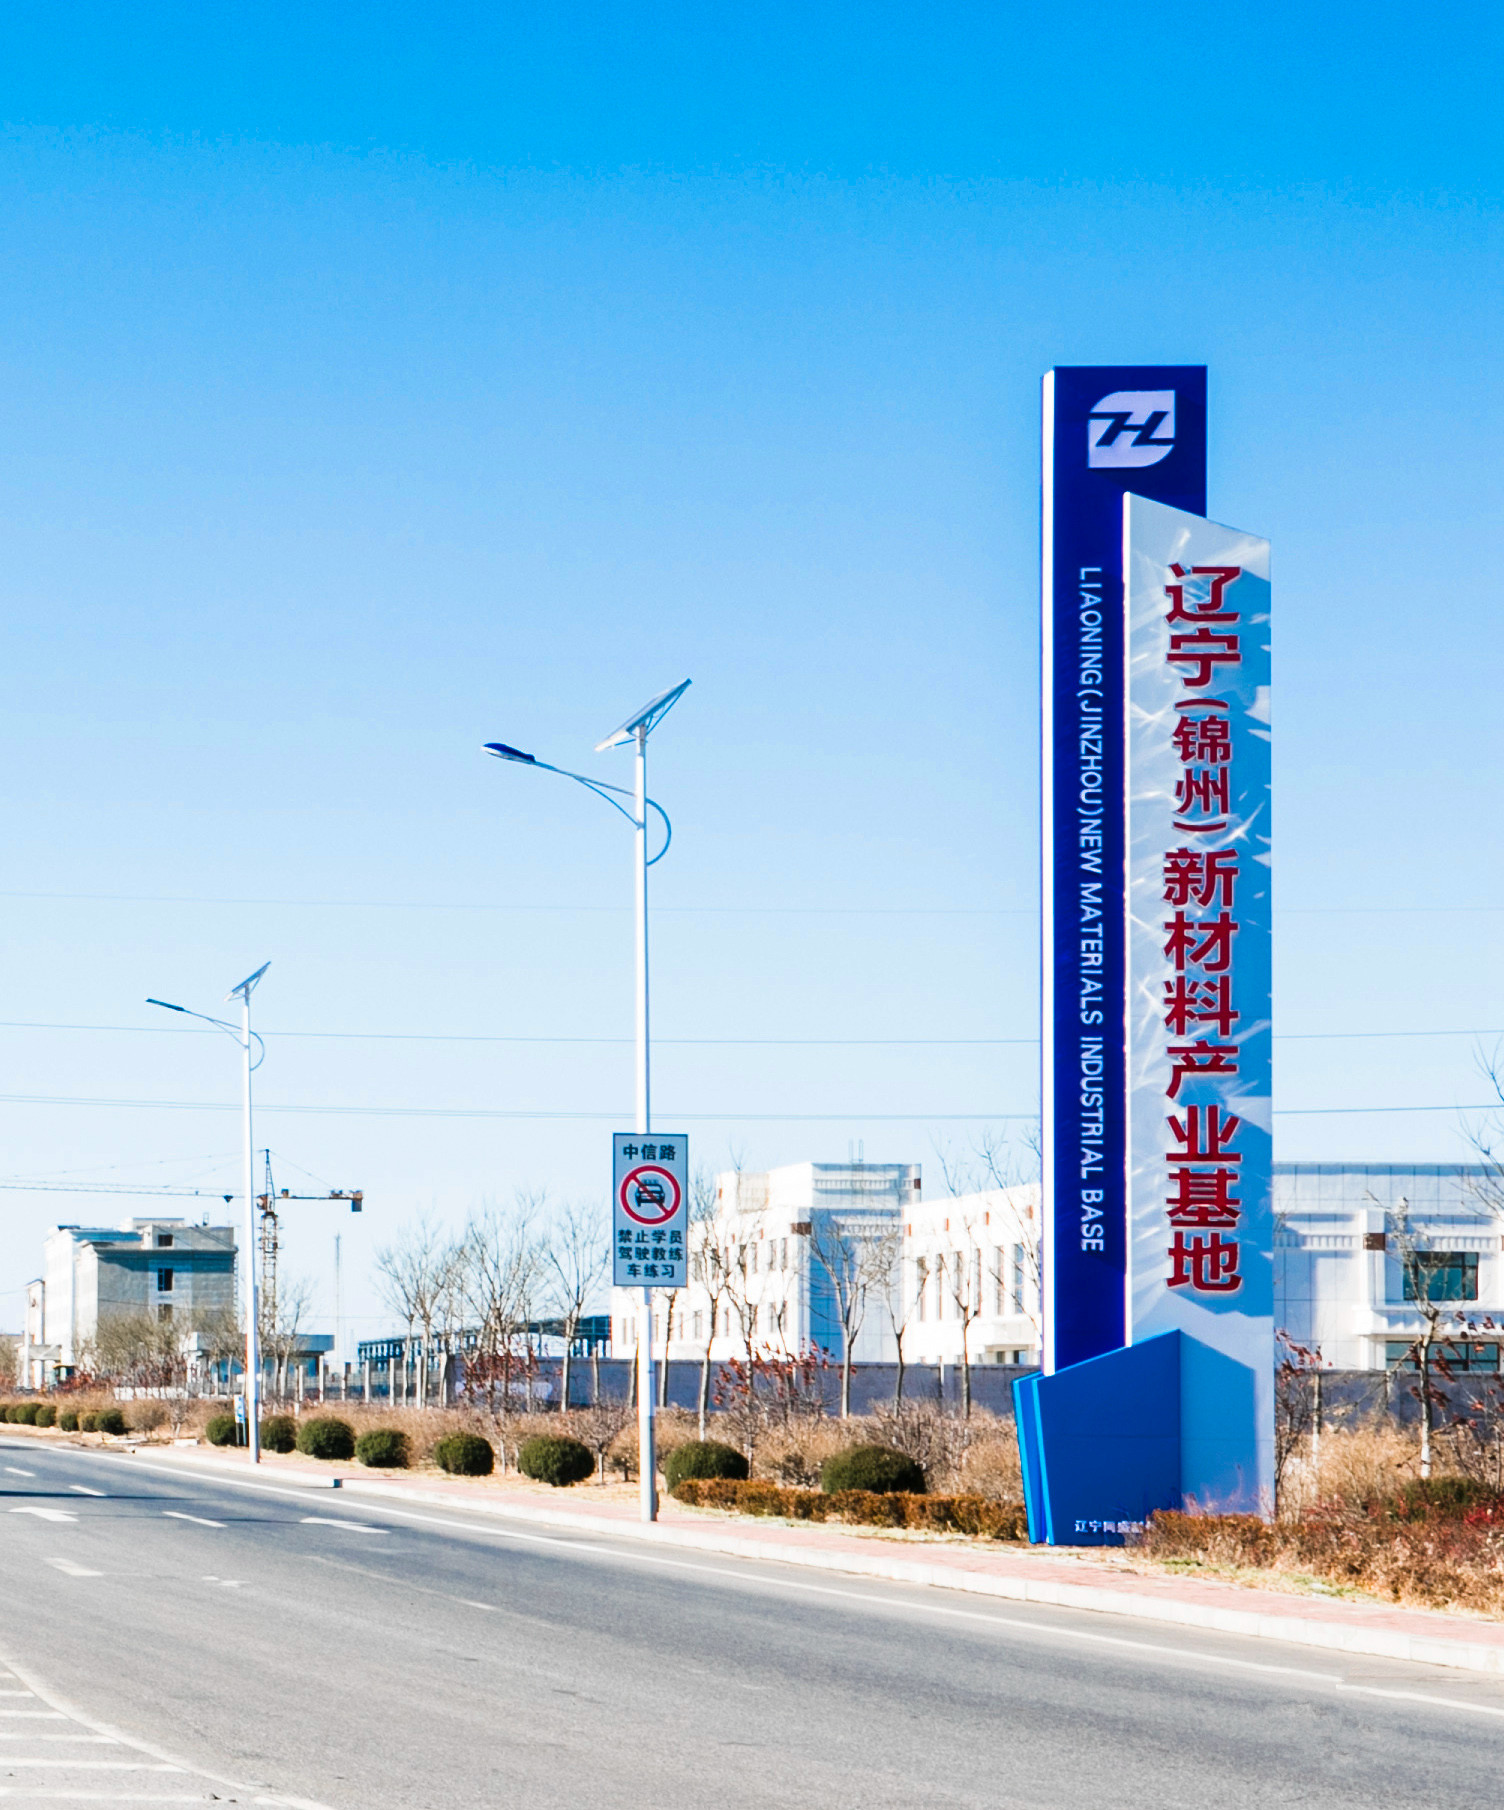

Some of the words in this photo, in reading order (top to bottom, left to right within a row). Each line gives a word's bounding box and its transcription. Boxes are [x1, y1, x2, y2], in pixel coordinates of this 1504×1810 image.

[1163, 562, 1241, 1293] 辽宁(锦州)新材料产业基地
[1079, 884, 1104, 1025] MATERIALS
[1080, 1037, 1104, 1180] INDUSTRIAL
[622, 1143, 676, 1161] 中信路
[617, 1229, 683, 1245] 禁止学员
[1080, 1190, 1104, 1253] BASE
[618, 1246, 684, 1261] 驾驶教练
[627, 1263, 675, 1278] 车练习
